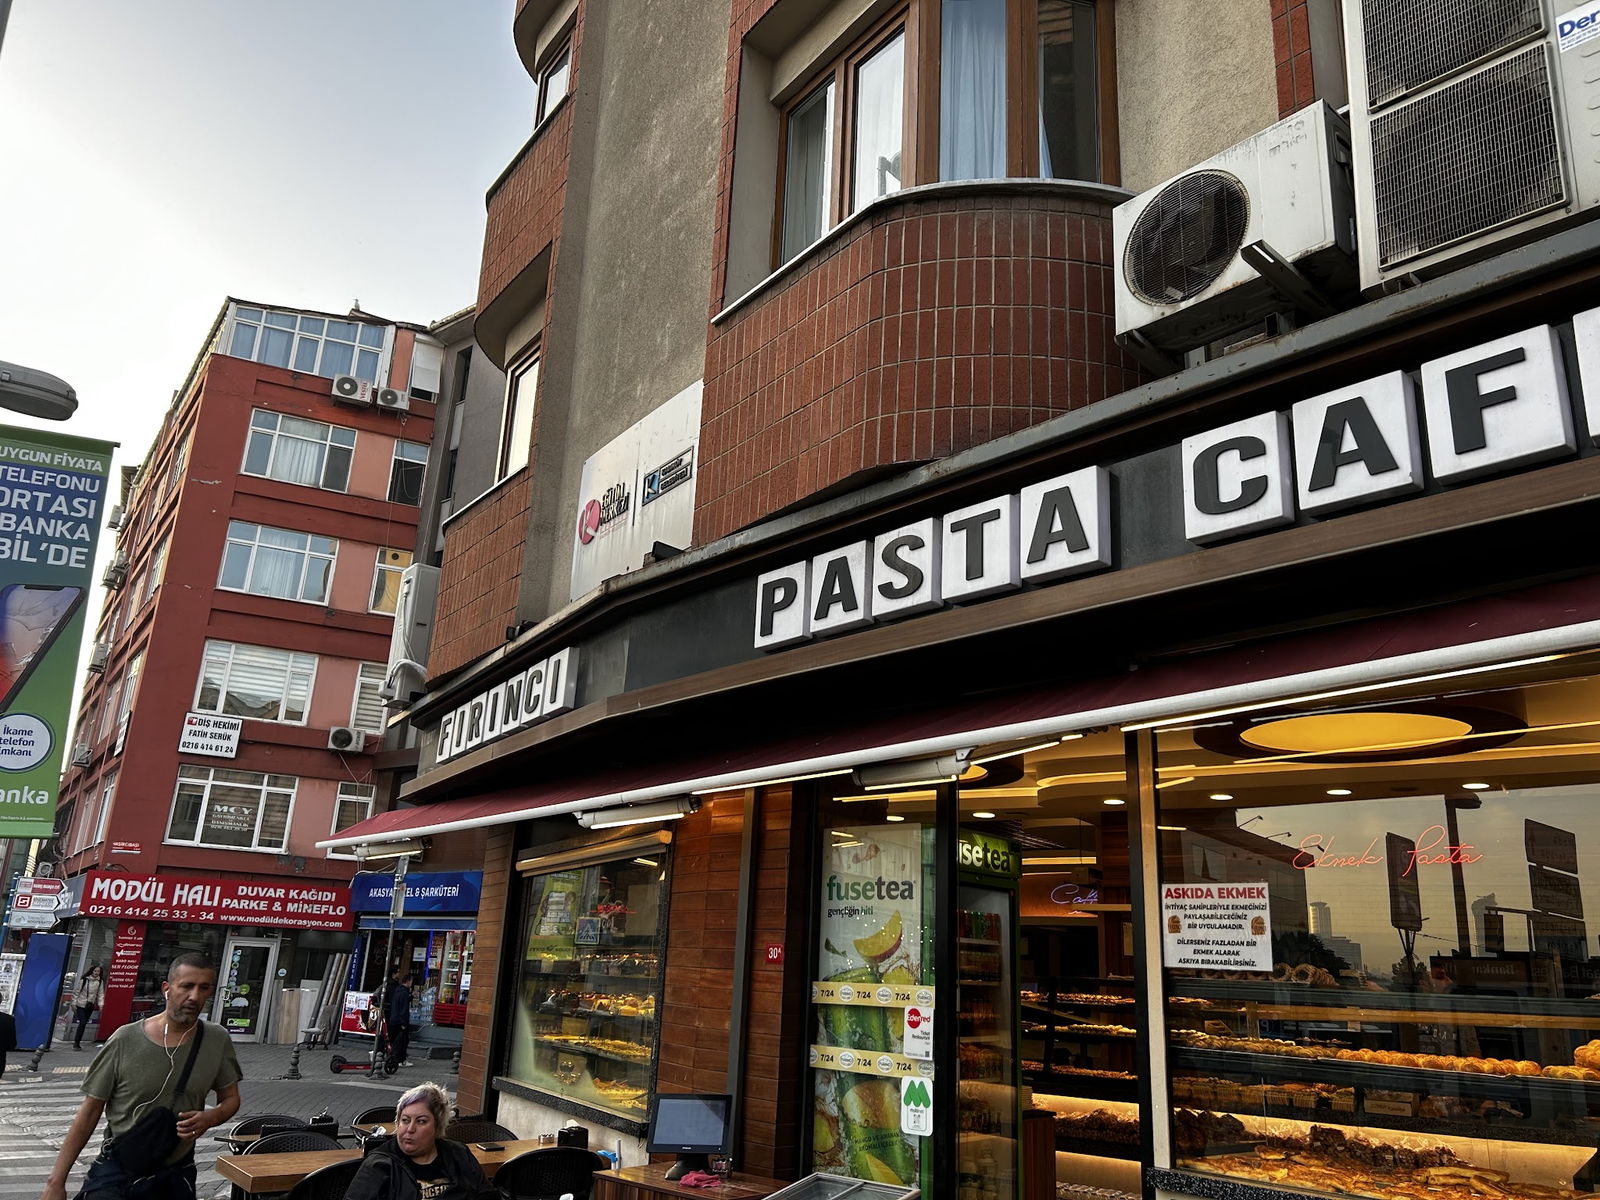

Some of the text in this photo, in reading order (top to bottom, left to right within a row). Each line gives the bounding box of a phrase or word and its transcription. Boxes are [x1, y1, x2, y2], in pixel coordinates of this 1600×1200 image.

[0, 446, 103, 472] UYGUN FİYATA
[0, 465, 100, 493] TELEFONU
[0, 512, 91, 542] BANKA
[438, 659, 561, 756] FIRINCI
[760, 485, 1090, 637] PASTA
[197, 717, 240, 731] DİŞ HEKİMİ
[188, 729, 232, 742] FATİH SERÜK
[181, 740, 199, 750] 0216
[200, 743, 214, 751] 414
[213, 804, 253, 815] MCY
[1402, 825, 1484, 877] Pasta
[90, 877, 166, 904] MODÜL
[172, 883, 221, 907] HALI
[237, 885, 337, 902] DUVAR KAĞIDI
[369, 887, 393, 898] AKASYA
[415, 887, 420, 897] &
[420, 883, 460, 900] ŞARKÜTERİ
[827, 874, 914, 901] fusetea
[1165, 887, 1266, 899] ASKIDA EKMEK
[89, 904, 122, 915] 0216
[124, 906, 149, 917] 414
[152, 908, 169, 918] 25
[172, 909, 188, 919] 33
[199, 911, 215, 921] 34
[221, 898, 347, 916] PARKE & MİNEFLO
[827, 905, 860, 918] gençliğin
[1164, 902, 1267, 912] İHTİYAÇ SAHİPLERİYLE EKMEĞİNİZİ
[1183, 912, 1248, 921] PAYLAŞABİLECEĞİNİZ
[1176, 938, 1257, 947] DİLERSENİZ FAZLADAN BİR
[1178, 957, 1257, 967] ASKIYA BIRAKABİLİRSİNİZ.
[820, 989, 834, 997] 7/24
[856, 991, 871, 999] 7/24
[895, 993, 911, 1001] 7/24
[820, 1054, 834, 1063] 7/24
[857, 1057, 872, 1067] 7/24
[896, 1062, 912, 1072] 7/24
